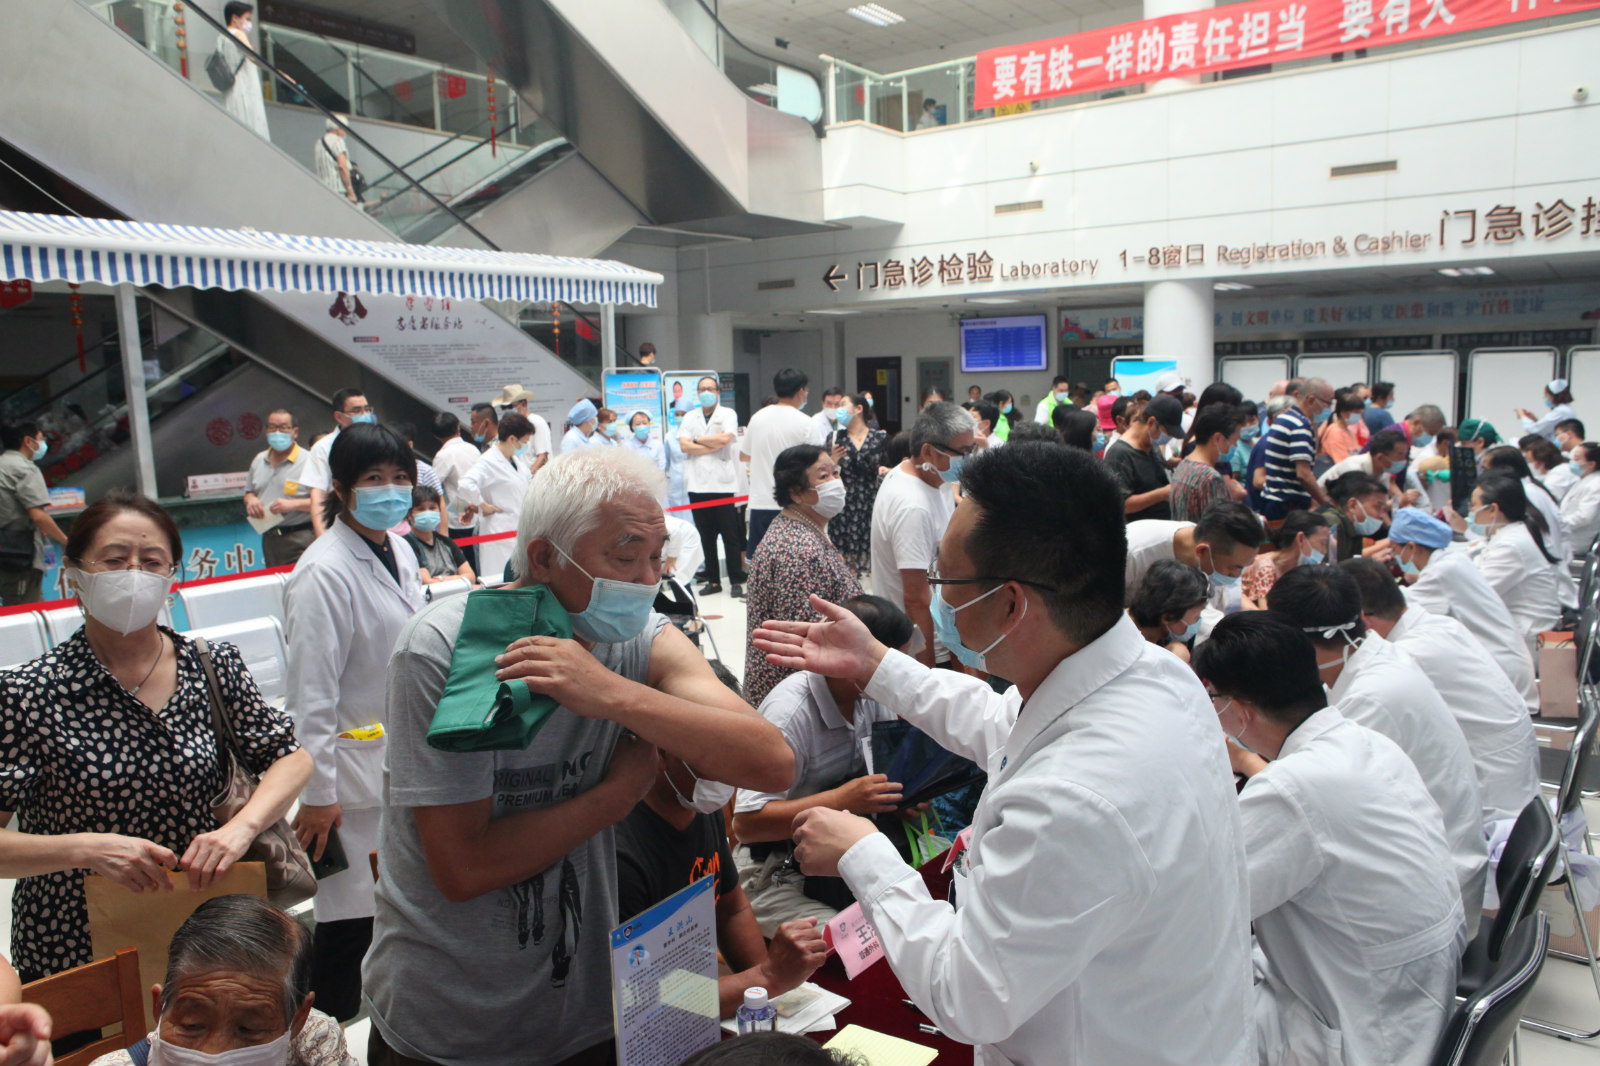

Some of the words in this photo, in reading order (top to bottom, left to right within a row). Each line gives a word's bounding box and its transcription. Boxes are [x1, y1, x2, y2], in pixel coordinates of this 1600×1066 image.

[992, 11, 1306, 100] 要有铁一样的责任担当
[1217, 239, 1326, 267] Registration
[1333, 236, 1348, 256] &
[1354, 231, 1432, 254] Cashier
[856, 250, 994, 290] 门急诊检验
[1000, 256, 1099, 280] Laboratory
[497, 789, 553, 807] PREMIUM
